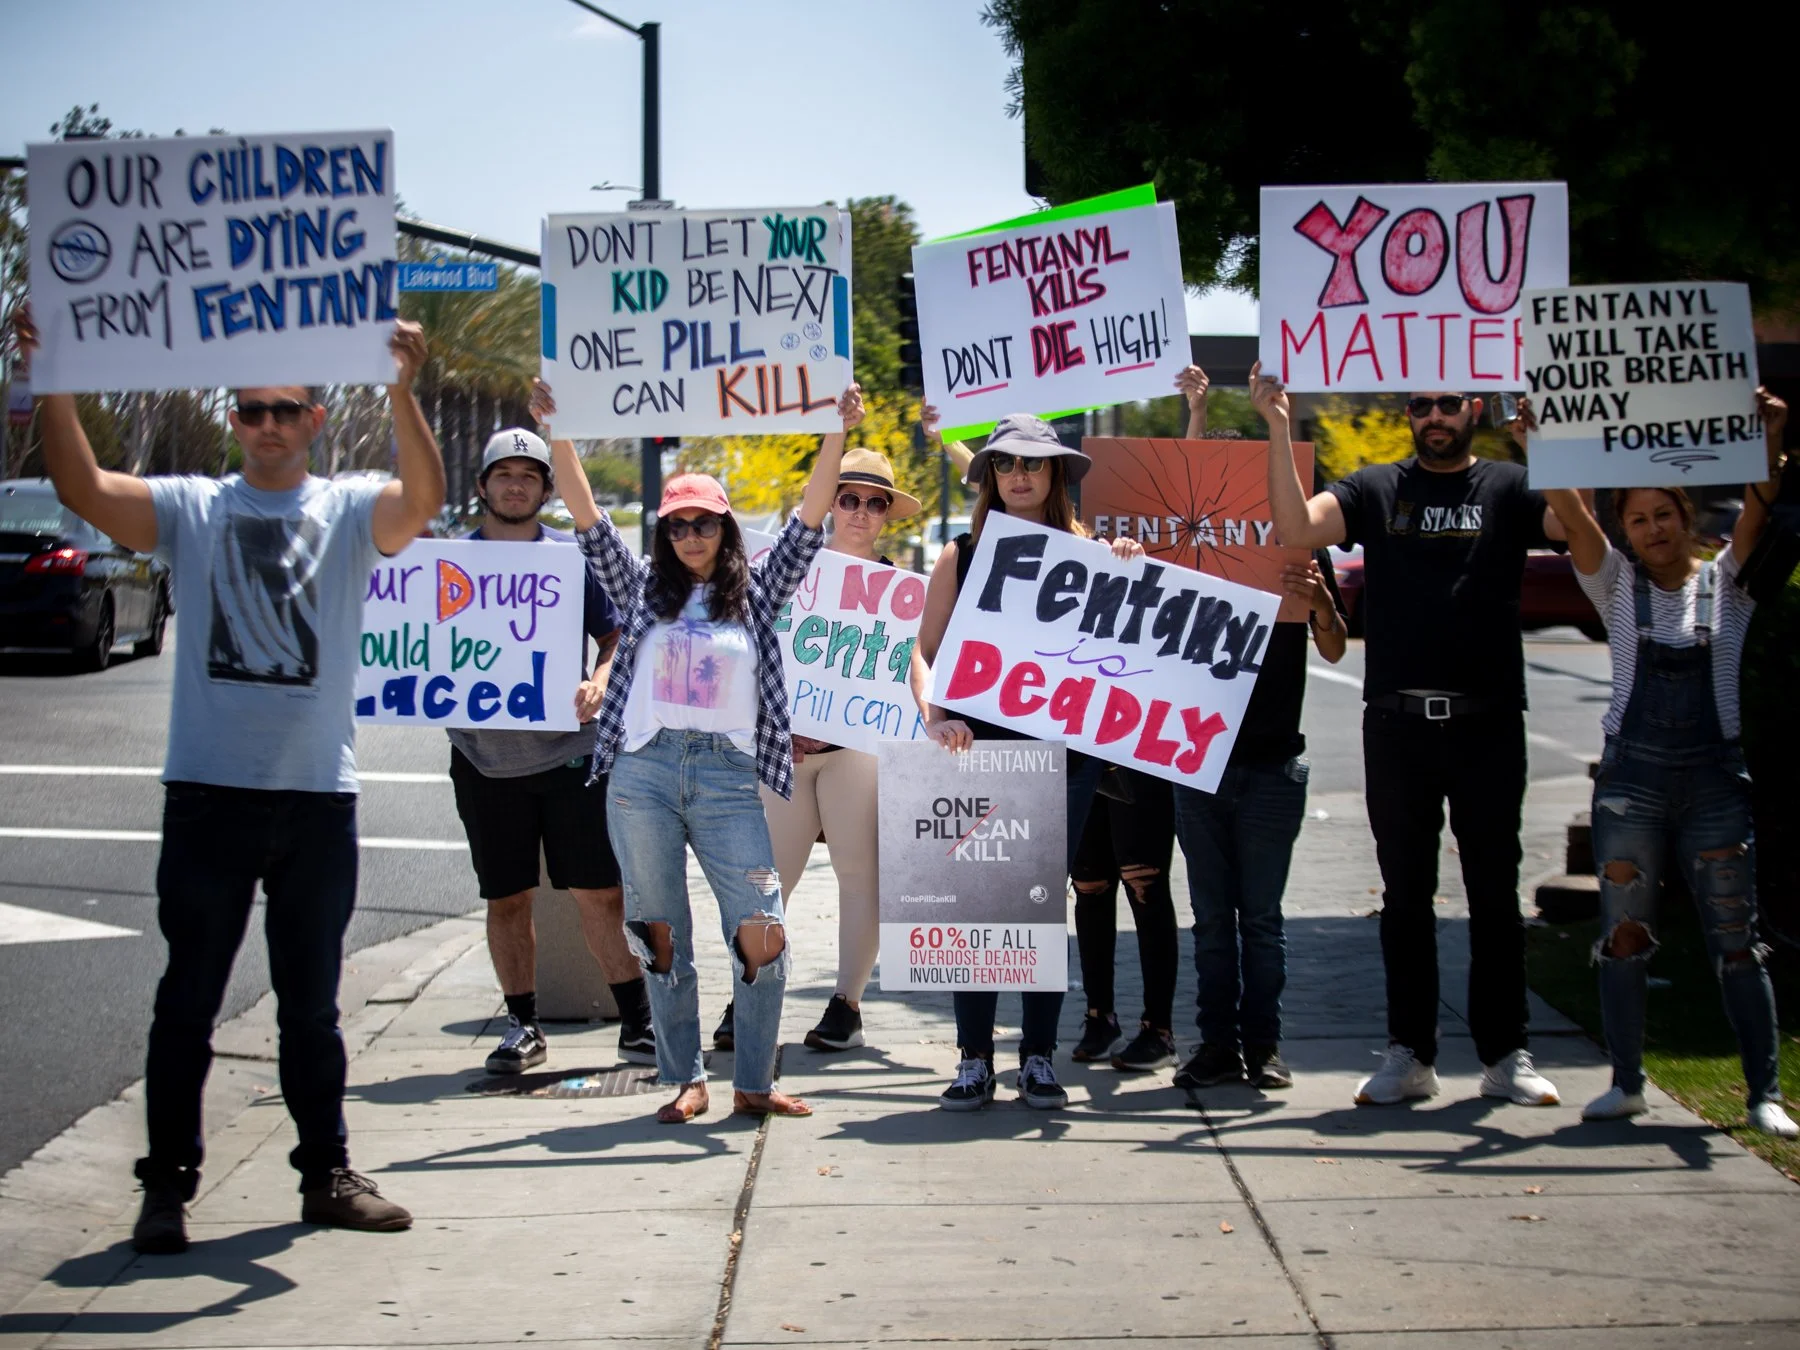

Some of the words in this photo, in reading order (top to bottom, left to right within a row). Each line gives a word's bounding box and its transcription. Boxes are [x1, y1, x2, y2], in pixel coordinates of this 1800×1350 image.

[66, 154, 162, 209] OUR
[188, 137, 387, 205] CHILDREN
[129, 218, 212, 278] ARE
[226, 205, 367, 272] DYING
[566, 221, 661, 269] DONT
[682, 217, 756, 261] LET
[763, 212, 827, 264] YOUR
[967, 226, 1130, 288] FENTANYL
[1293, 193, 1535, 315] YOU
[403, 265, 463, 288] Lakewood
[467, 265, 495, 287] Blvd
[611, 269, 669, 314] KID
[688, 269, 728, 308] BE
[733, 264, 839, 324] NEXT
[1026, 267, 1106, 318] KILLS
[70, 282, 172, 349] FROM
[192, 259, 399, 341] FENTANYL
[1532, 289, 1718, 325] FENTANYL
[570, 327, 643, 371] ONE
[662, 319, 766, 371] PILL
[1030, 320, 1085, 378] DIE
[1090, 298, 1172, 365] HIGH!
[1548, 327, 1626, 360] WILL
[1634, 323, 1719, 354] TAKE
[613, 378, 684, 415] CAN
[717, 364, 837, 418] KILL
[1525, 360, 1612, 394] YOUR
[1624, 352, 1748, 384] BREATH
[1540, 391, 1630, 425] AWAY
[513, 434, 528, 452] LA
[1603, 414, 1763, 452] FOREVER!!
[1095, 514, 1285, 547] FENTANY
[1421, 503, 1482, 532] STACKS
[436, 558, 561, 642] Drugs
[839, 564, 926, 621] NO
[360, 622, 430, 672] ould
[451, 626, 502, 672] be
[1034, 637, 1154, 678] is
[792, 679, 834, 722] Pill
[958, 750, 1058, 773] #FENTANYL
[932, 797, 990, 818] ONE
[916, 819, 967, 840] PILL
[971, 819, 1030, 840] CAN
[955, 841, 1011, 862] KILL
[900, 894, 957, 904] #OnePillCanKill
[910, 927, 967, 949] 60%
[970, 929, 992, 949] OF
[1002, 929, 1037, 949] ALL
[910, 950, 980, 966] OVERDOSE
[985, 950, 1037, 966] DEATHS
[910, 968, 970, 984] INVOLVED
[973, 968, 1037, 984] FENTANYL
